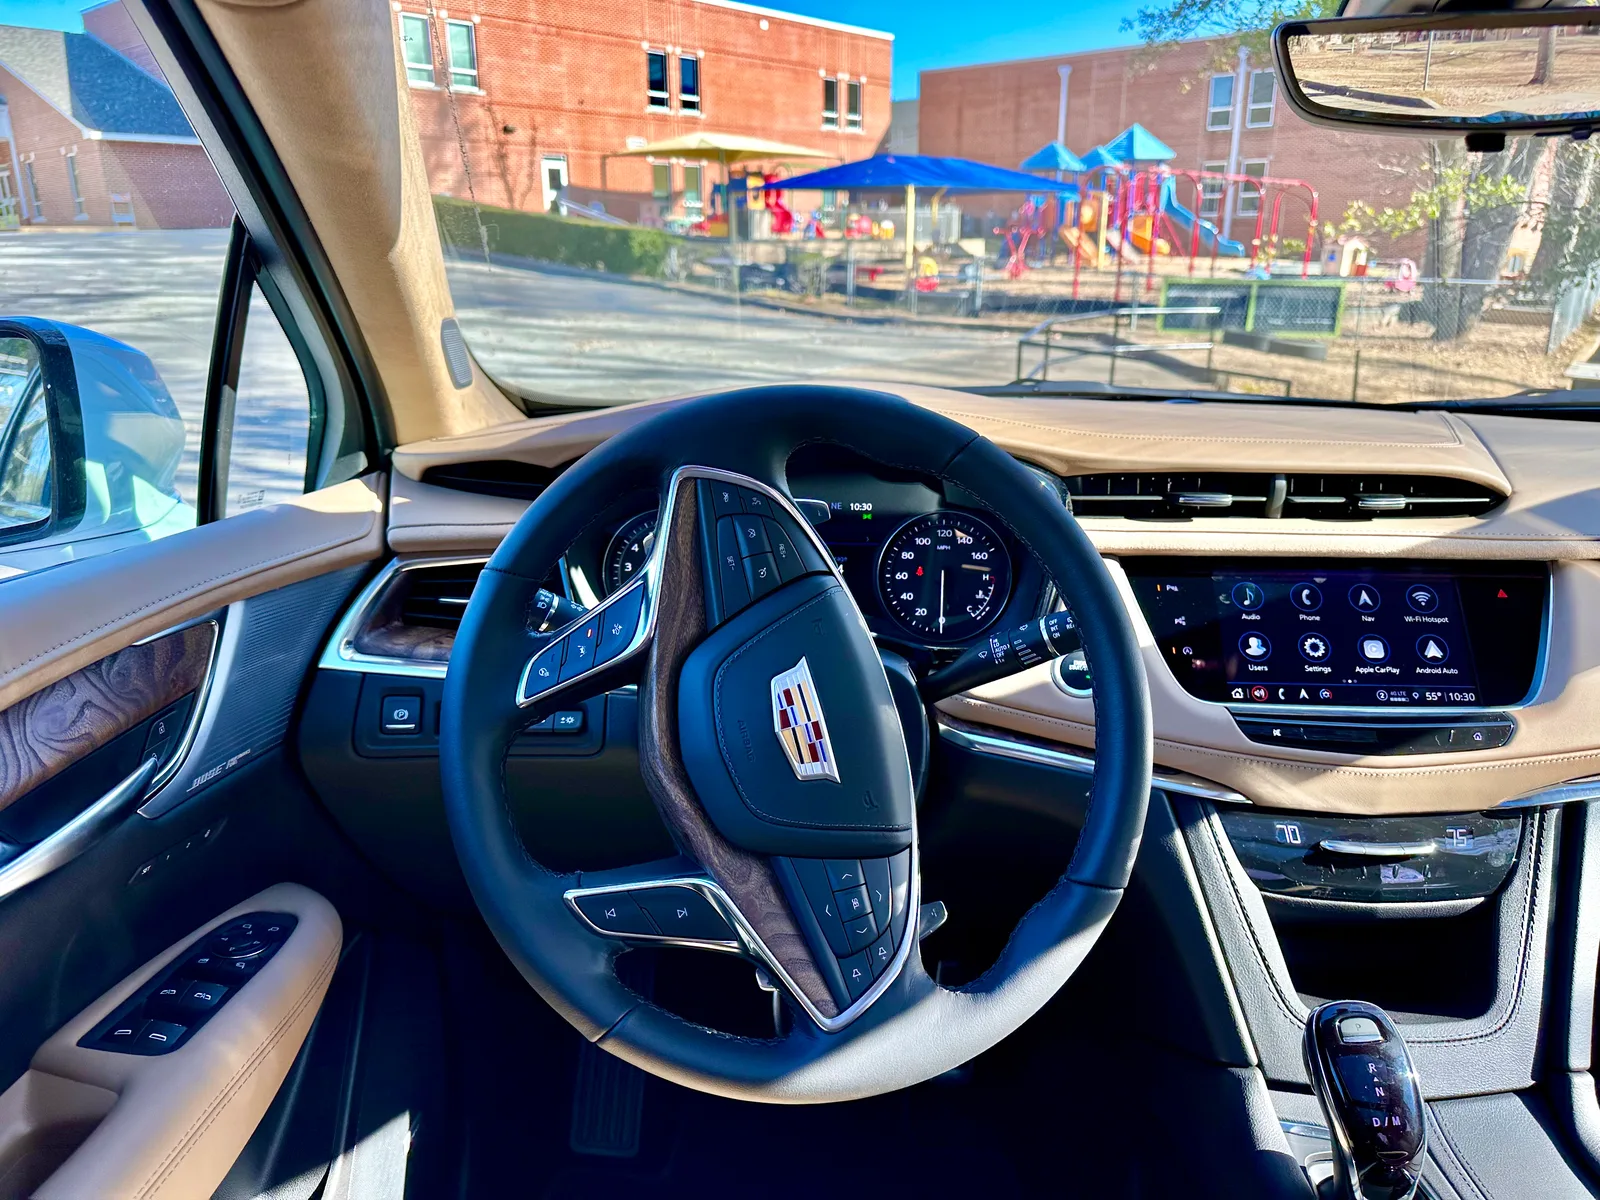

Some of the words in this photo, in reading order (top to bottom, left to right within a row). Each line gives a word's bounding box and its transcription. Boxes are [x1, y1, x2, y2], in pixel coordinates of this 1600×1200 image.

[831, 502, 842, 510] NE
[850, 503, 872, 511] 10:30
[937, 529, 953, 537] 120
[915, 538, 931, 546] 100
[956, 536, 973, 545] 140
[631, 543, 639, 552] 4
[971, 552, 988, 560] 160
[624, 562, 633, 572] 3
[895, 572, 908, 580] 60
[900, 592, 914, 600] 40
[915, 608, 927, 616] 20
[966, 605, 973, 613] C
[1422, 616, 1449, 624] Hotspot
[1304, 664, 1332, 674] Settings
[1355, 666, 1374, 674] Apple
[1375, 666, 1400, 675] CarPlay
[1416, 667, 1441, 675] Android
[1425, 692, 1442, 701] 55°
[1448, 692, 1476, 701] 10:30
[1275, 823, 1301, 844] 70
[1446, 828, 1468, 848] 75
[1368, 1062, 1377, 1073] R
[1375, 1086, 1385, 1098] N
